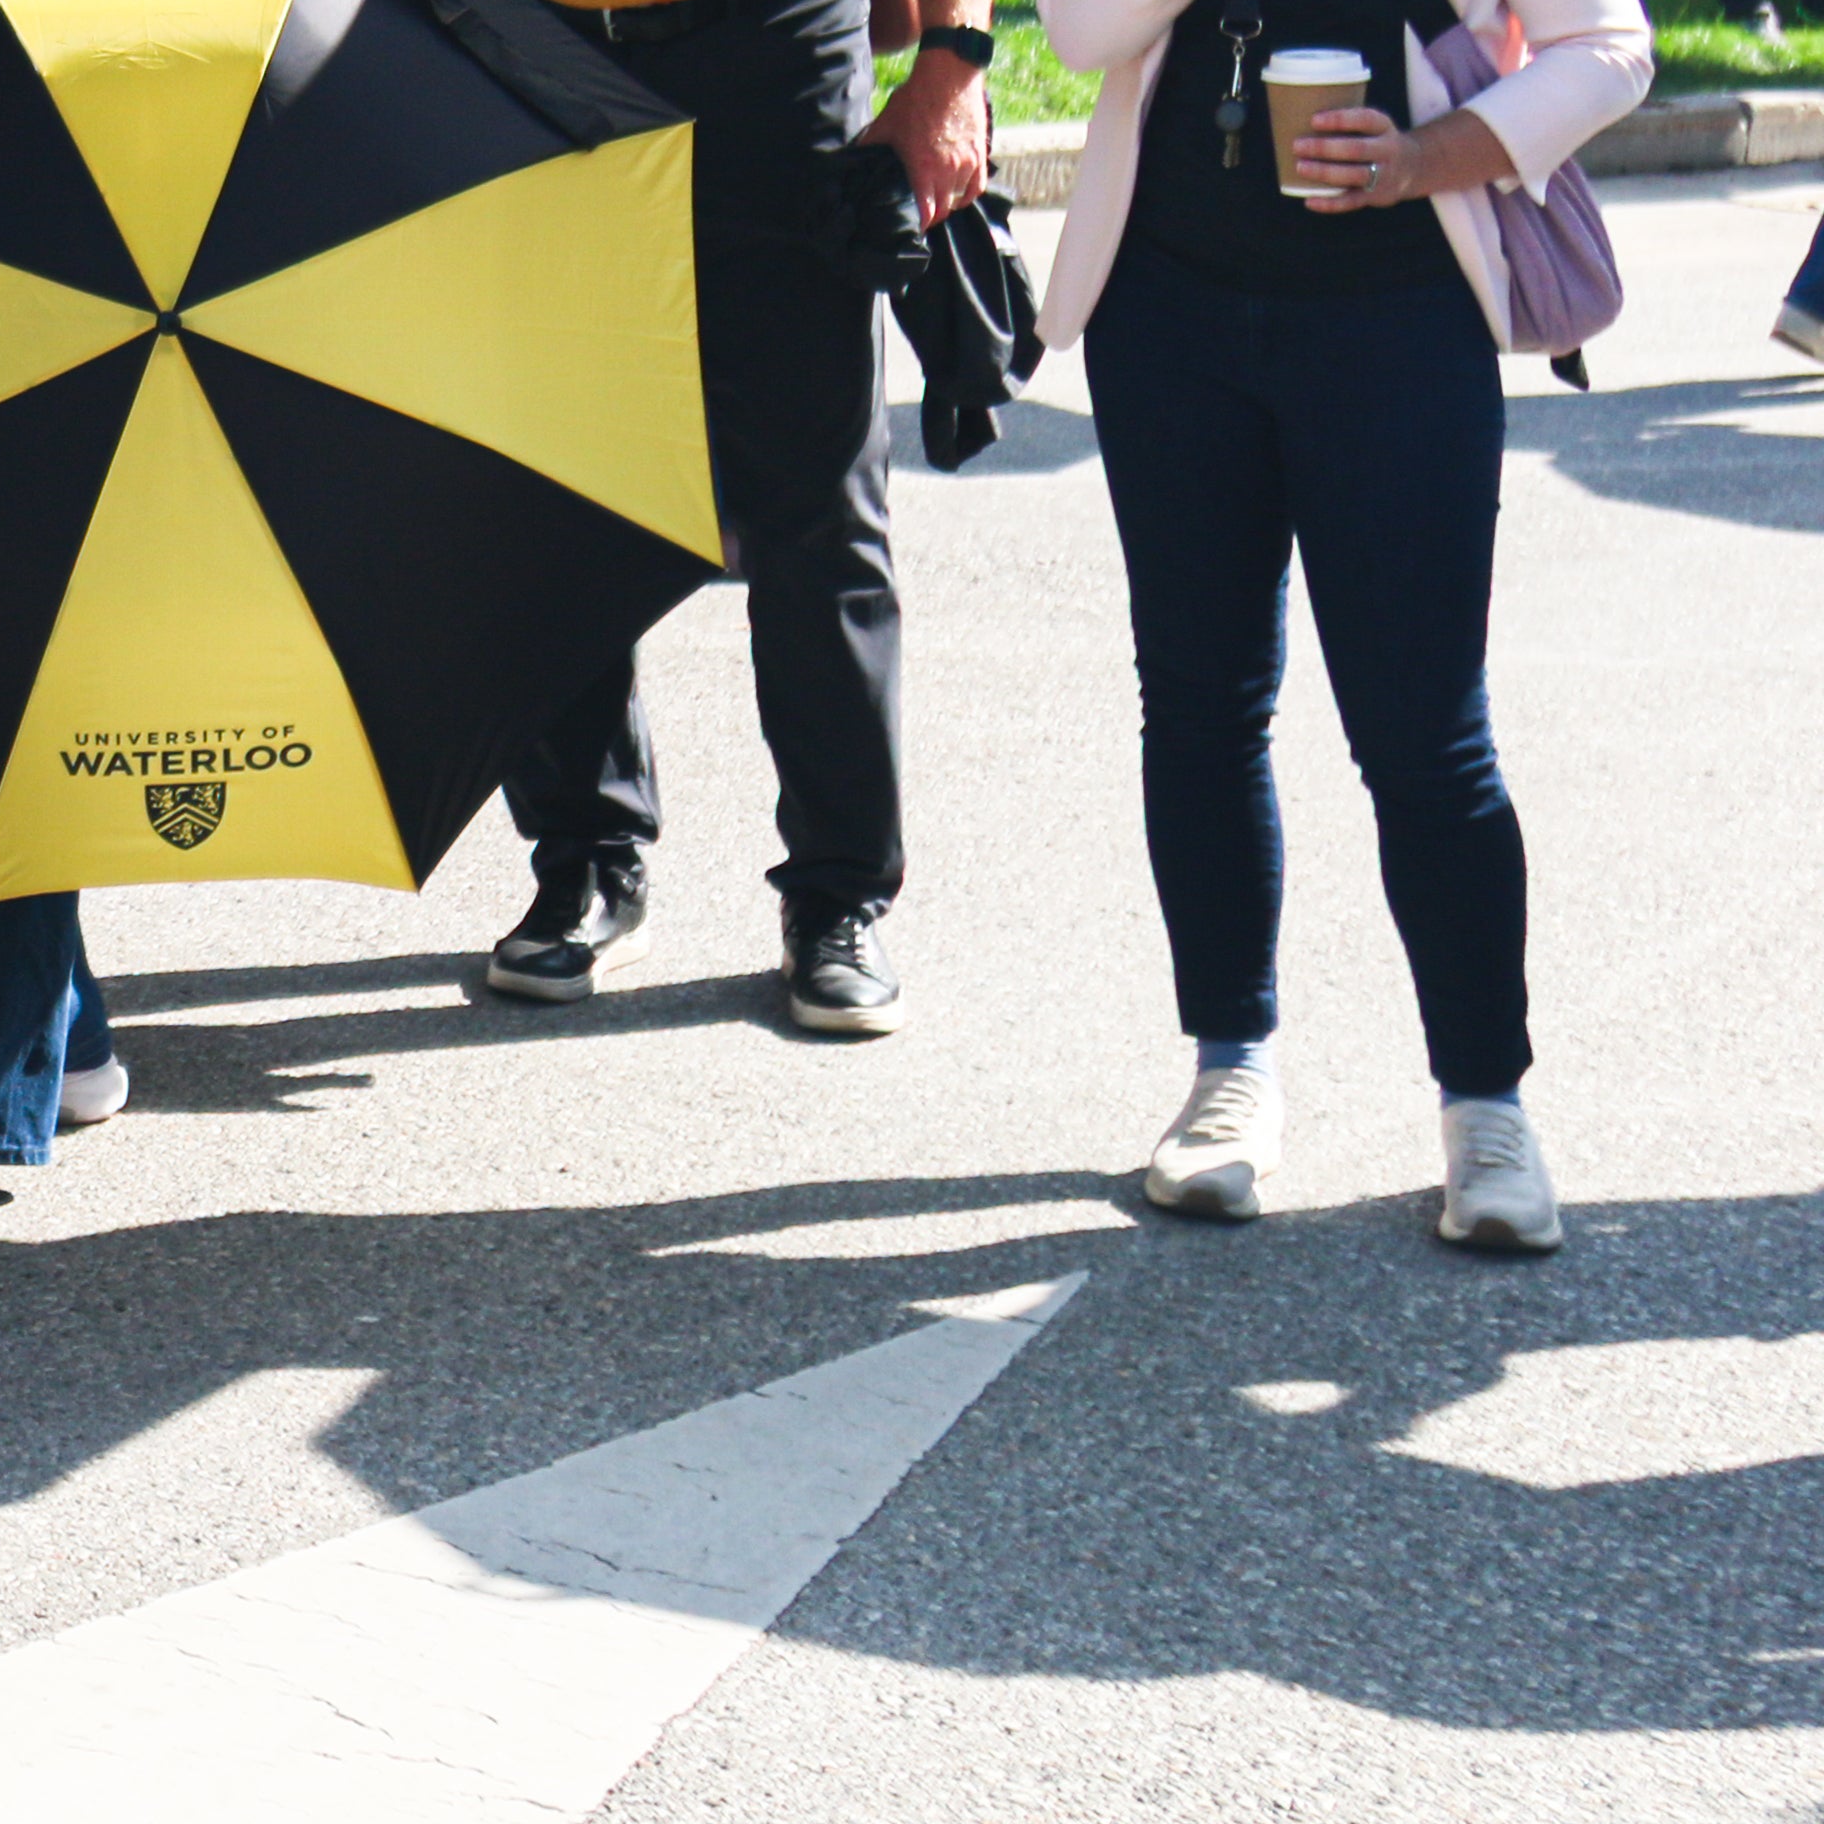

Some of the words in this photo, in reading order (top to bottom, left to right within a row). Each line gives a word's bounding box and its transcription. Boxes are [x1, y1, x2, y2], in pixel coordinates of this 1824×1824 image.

[74, 728, 246, 746] UNIVERSITY
[261, 724, 295, 740] OF
[59, 742, 313, 777] WATERLOO
